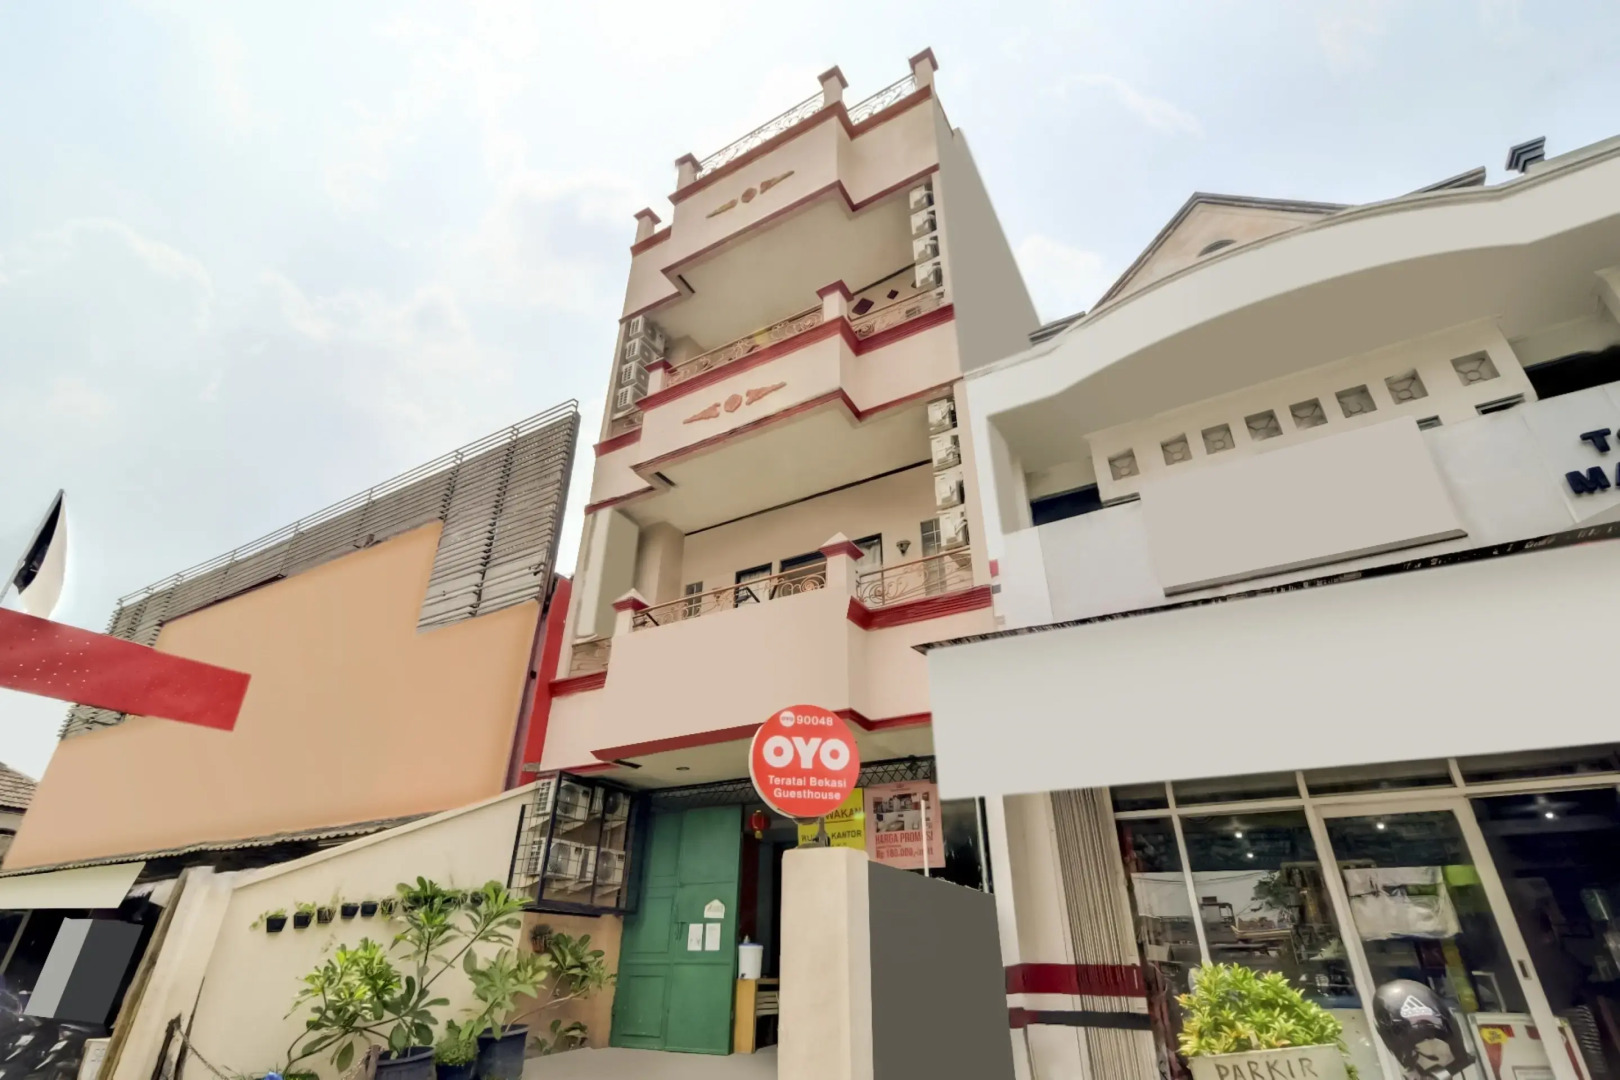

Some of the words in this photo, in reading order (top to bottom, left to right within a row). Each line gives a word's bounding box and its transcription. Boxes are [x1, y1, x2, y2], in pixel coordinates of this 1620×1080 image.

[1580, 428, 1620, 453] T
[796, 714, 834, 727] 90048
[763, 735, 850, 770] OYO
[768, 775, 806, 787] Teratai
[810, 776, 847, 788] Bekasi
[773, 787, 841, 800] Guesthouse
[831, 829, 862, 840] KANTOR
[875, 833, 898, 845] HARGA
[900, 830, 934, 843] PROMSI
[1215, 1058, 1318, 1080] PARKIR
